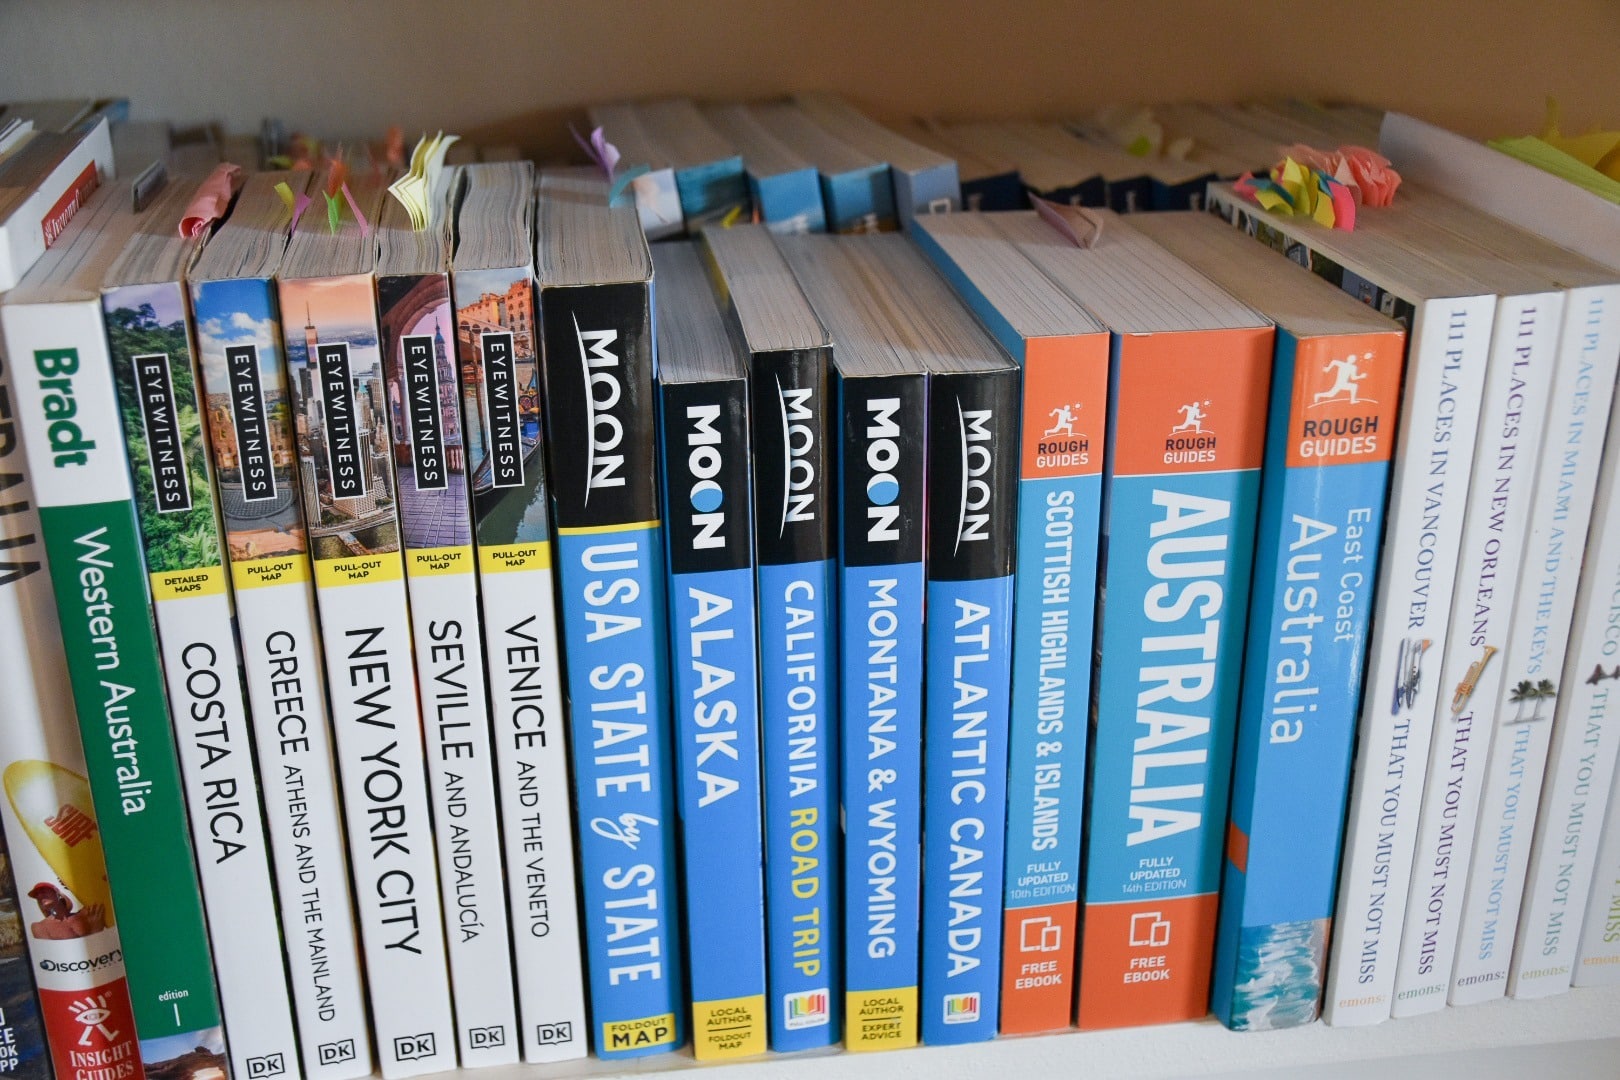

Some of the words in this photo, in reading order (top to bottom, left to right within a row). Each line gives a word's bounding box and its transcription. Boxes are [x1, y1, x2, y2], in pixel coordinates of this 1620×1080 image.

[1433, 349, 1463, 442] PLACES
[1502, 346, 1532, 438] PLACES
[1572, 333, 1599, 417] PLACES
[33, 347, 96, 468] Bradt
[235, 354, 267, 492] EYEWITNESS
[326, 353, 356, 490] EYEWITNESS
[411, 345, 438, 482] EYEWITNESS
[490, 343, 515, 478] EYEWITNESS
[581, 329, 626, 489] MOON
[1302, 415, 1379, 438] ROUGH
[143, 365, 181, 503] EYEWITNESS
[1037, 439, 1089, 455] ROUGH
[1165, 436, 1216, 451] ROUGH
[1300, 436, 1377, 459] GUIDES
[1567, 421, 1584, 444] IN
[686, 404, 726, 549] MOON
[782, 388, 815, 523] MOON
[866, 397, 900, 542] MOON
[960, 410, 992, 541] MOON
[1036, 452, 1089, 468] GUIDES
[1163, 449, 1216, 464] GUIDES
[1428, 450, 1449, 476] IN
[1496, 445, 1516, 470] IN
[1488, 477, 1511, 533] NEW
[1552, 450, 1579, 521] MIAMI
[416, 552, 462, 563] PULL-OUT
[492, 550, 537, 560] PULL-OUT
[1043, 490, 1075, 604] SCOTTISH
[1344, 507, 1372, 564] East
[1408, 481, 1445, 630] VANCOUVER
[1545, 527, 1565, 573] AND
[164, 575, 208, 587] DETAILED
[247, 562, 294, 575] PULL-OUT
[261, 571, 282, 581] MAP
[334, 561, 382, 573] PULL-OUT
[348, 569, 369, 579] MAP
[430, 561, 451, 570] MAP
[505, 557, 526, 567] MAP
[174, 582, 201, 592] MAPS
[581, 542, 642, 643] USA
[1334, 572, 1364, 644] Coast
[1470, 538, 1500, 647] ORLEANS
[1537, 576, 1556, 620] THE
[1269, 513, 1338, 746] Australia
[1527, 624, 1549, 675] KEYS
[73, 526, 120, 670] Western
[99, 680, 152, 816] Australia
[345, 627, 396, 730] NEW
[504, 615, 546, 750] VENICE
[784, 580, 818, 798] CALIFORNIA
[868, 578, 898, 761] MONTANA
[1036, 609, 1069, 734] HIGHLANDS
[1126, 488, 1231, 847] AUSTRALIA
[181, 642, 232, 770] COSTA
[265, 630, 310, 755] GREECE
[429, 620, 474, 761] SEVILLE
[688, 587, 740, 808] ALASKA
[951, 598, 991, 805] ATLANTIC
[589, 663, 651, 797] STATE
[1584, 688, 1610, 748] THAT
[1036, 742, 1062, 757] &
[1387, 718, 1410, 779] THAT
[1451, 711, 1474, 771] THAT
[1507, 724, 1531, 783] THAT
[444, 771, 466, 818] AND
[516, 761, 538, 808] AND
[868, 768, 897, 793] &
[1444, 774, 1464, 818] YOU
[1576, 751, 1596, 798] YOU
[203, 778, 247, 864] RICA
[283, 765, 310, 838] ATHENS
[361, 742, 410, 860] YORK
[1032, 763, 1062, 851] ISLANDS
[1380, 784, 1401, 828] YOU
[1502, 784, 1521, 823] YOU
[522, 813, 542, 853] THE
[591, 812, 659, 850] by
[1433, 821, 1456, 880] MUST
[1494, 824, 1513, 875] MUST
[1564, 801, 1585, 857] MUST
[294, 844, 316, 884] AND
[789, 807, 820, 899] ROAD
[1027, 861, 1061, 874] FULLY
[1130, 868, 1180, 881] UPDATED
[1139, 856, 1173, 869] FULLY
[1372, 832, 1395, 888] MUST
[449, 824, 485, 943] ANDALUCÍA
[525, 857, 549, 938] VENETO
[867, 798, 896, 960] WYOMING
[946, 817, 985, 979] CANADA
[1010, 888, 1032, 899] 10th
[1032, 883, 1075, 897] EDITION
[1018, 872, 1069, 887] UPDATED
[1122, 882, 1143, 894] 14th
[1144, 879, 1187, 893] EDITION
[1486, 878, 1505, 917] NOT
[1552, 864, 1574, 905] NOT
[301, 887, 322, 924] THE
[376, 870, 422, 955] CITY
[602, 863, 661, 986] STATE
[1365, 894, 1386, 938] NOT
[1427, 884, 1447, 928] NOT
[792, 908, 820, 977] TRIP
[1418, 930, 1438, 976] MISS
[1478, 919, 1498, 961] MISS
[1543, 911, 1564, 956] MISS
[308, 929, 335, 1022] MAINLAND
[1015, 974, 1062, 990] EBOOK
[1021, 960, 1057, 975] FREE
[1123, 968, 1170, 984] EBOOK
[1130, 955, 1166, 969] FREE
[1359, 940, 1377, 985] MISS
[1457, 970, 1505, 987] emons:
[1584, 955, 1620, 966] emon
[158, 989, 189, 1001] edition
[711, 1006, 747, 1017] LOCAL
[859, 1005, 904, 1015] AUTHOR
[864, 997, 899, 1007] LOCAL
[1397, 984, 1446, 1001] emons:
[474, 1030, 500, 1044] DK
[541, 1026, 568, 1041] DK
[611, 1017, 666, 1032] FOLDOUT
[612, 1028, 668, 1048] MAP
[707, 1014, 752, 1026] AUTHOR
[709, 1032, 751, 1042] FOLDOUT
[861, 1030, 901, 1040] ADVICE
[862, 1022, 901, 1032] EXPERT
[69, 1041, 132, 1067] INSIGHT
[252, 1058, 279, 1074] DK
[324, 1044, 351, 1061] DK
[400, 1039, 431, 1056] DK
[718, 1041, 742, 1050] MAP
[76, 1061, 134, 1080] GUIDES
